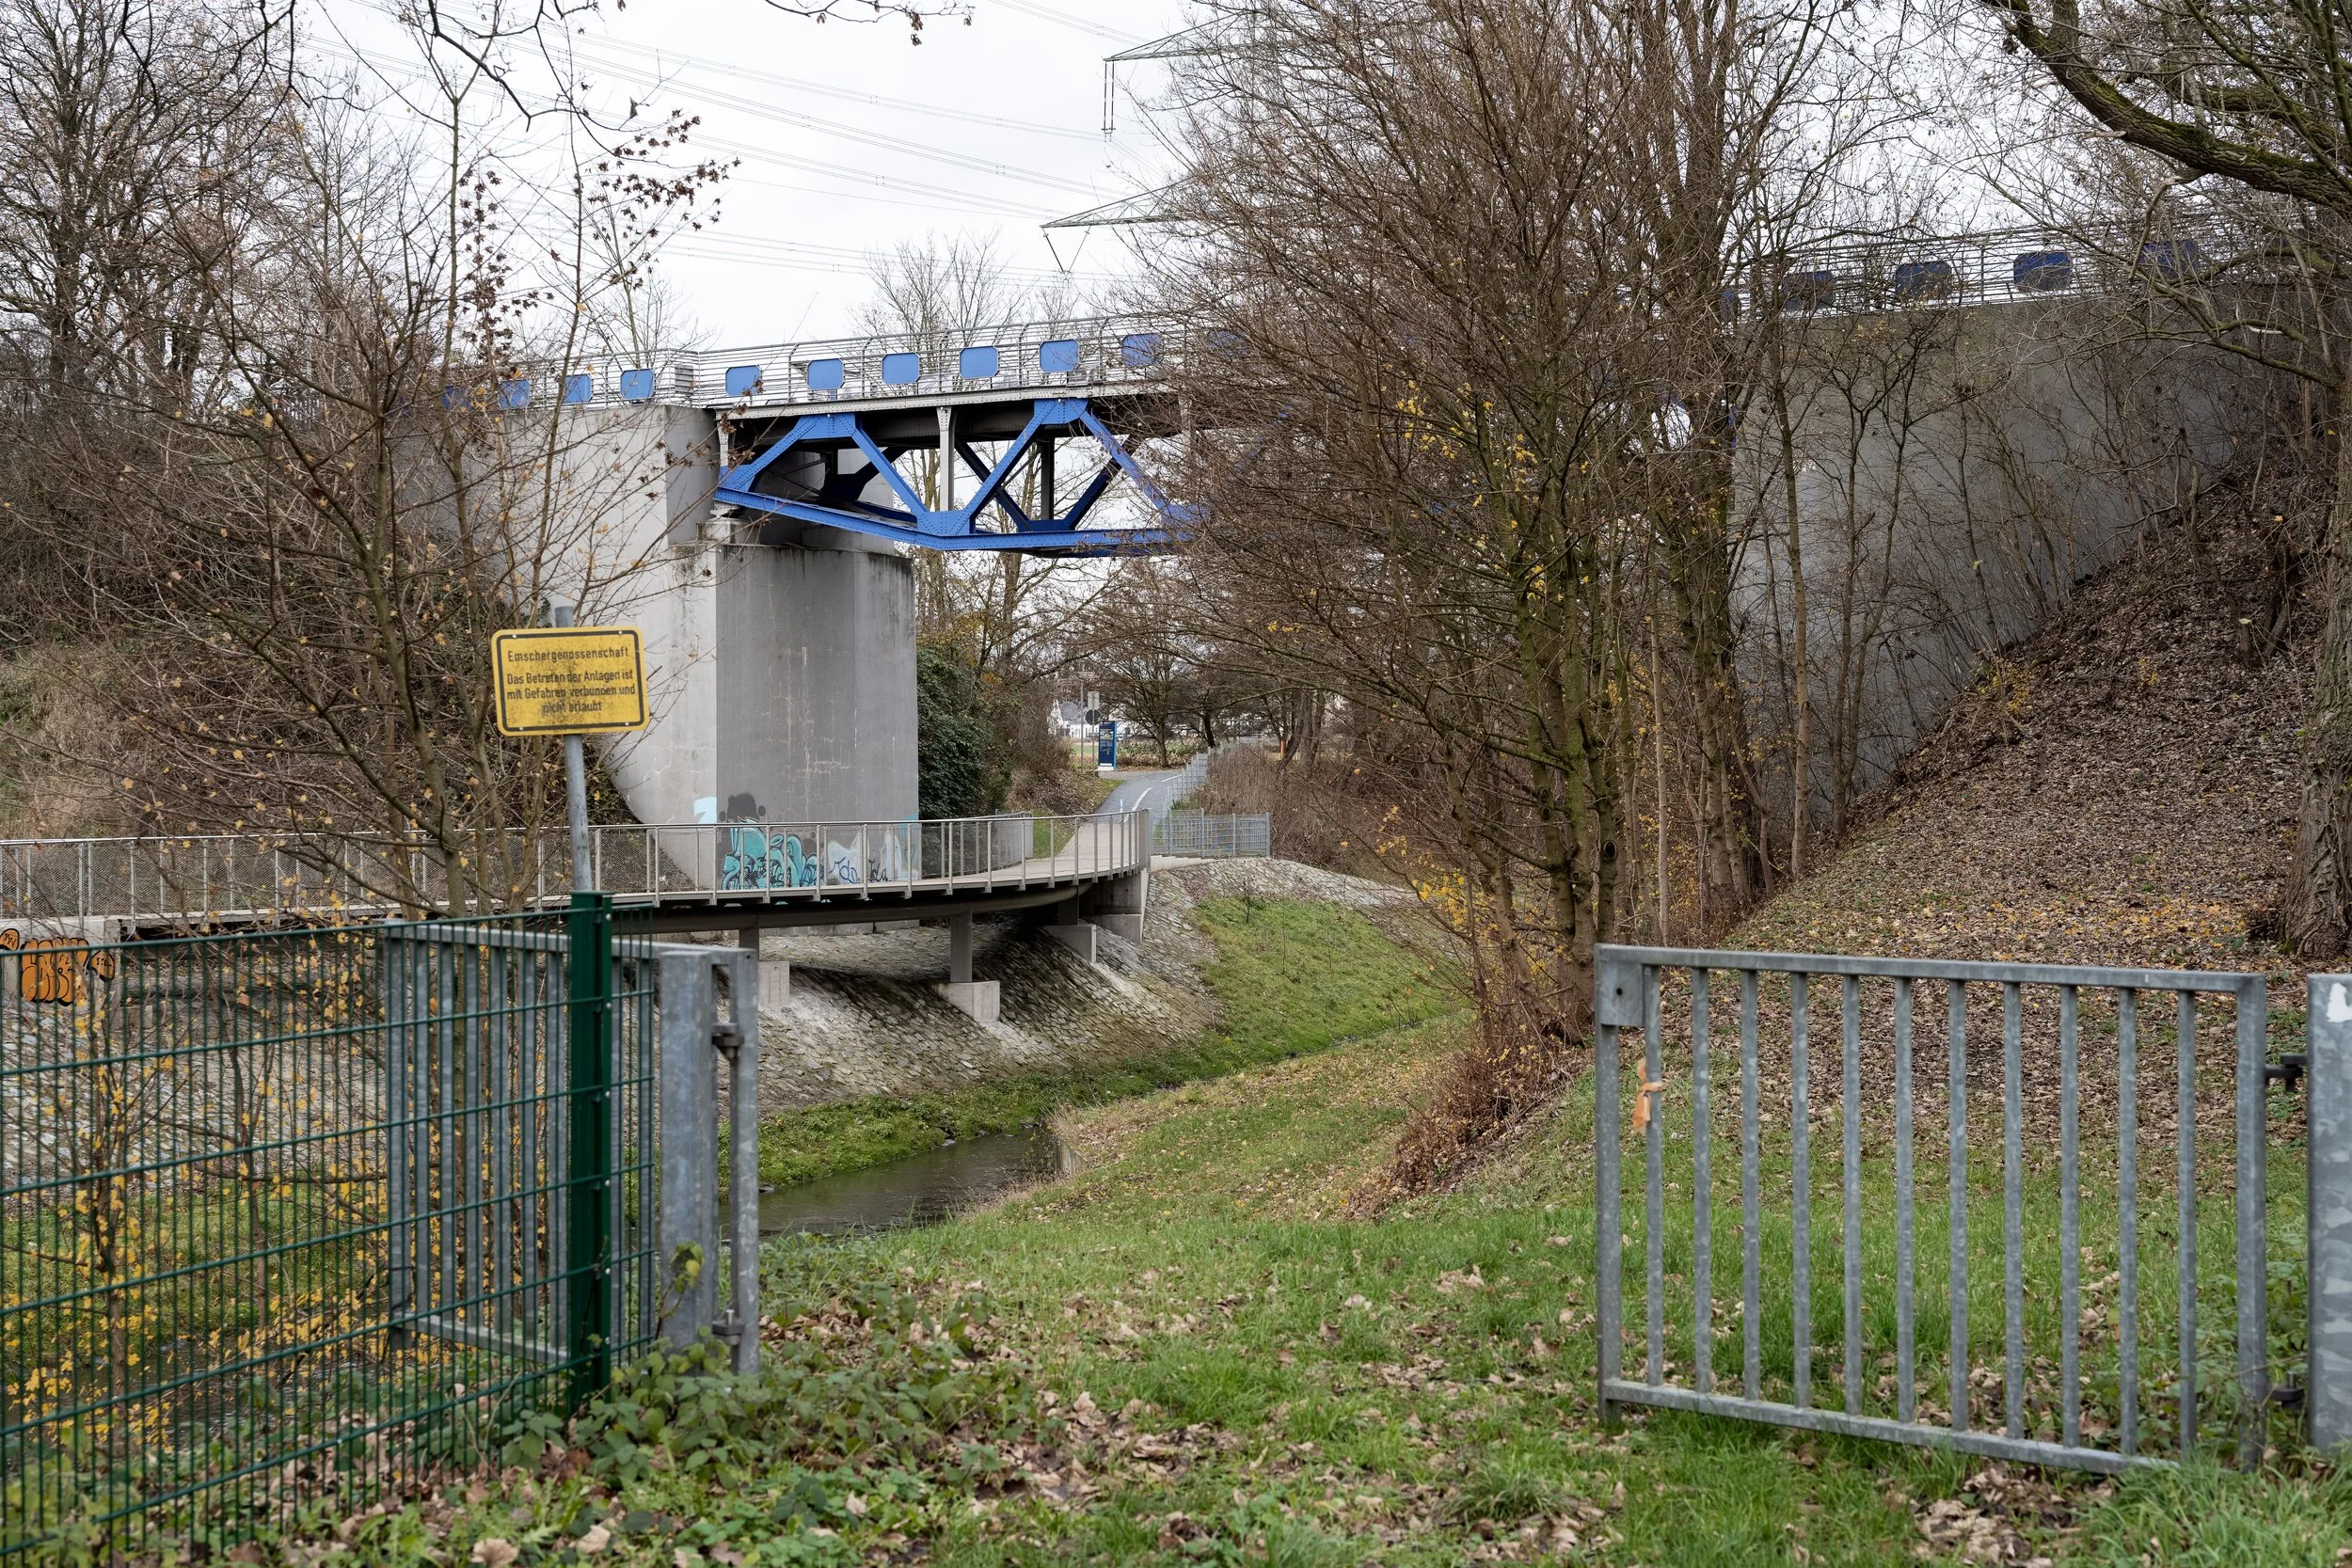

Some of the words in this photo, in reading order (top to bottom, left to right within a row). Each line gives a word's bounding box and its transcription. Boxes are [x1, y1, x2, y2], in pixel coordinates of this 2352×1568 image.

[508, 647, 628, 662] Emschergenossenschaft
[507, 673, 524, 685] Das
[527, 673, 564, 683] Betreten
[567, 671, 580, 682] der
[584, 671, 620, 683] Anlagen
[622, 670, 633, 680] ist
[508, 689, 522, 700] mit
[525, 688, 565, 699] Gefahren
[570, 685, 616, 696] verbunden
[619, 684, 635, 694] und
[543, 702, 564, 713] nicht
[569, 701, 602, 712] erlaubt
